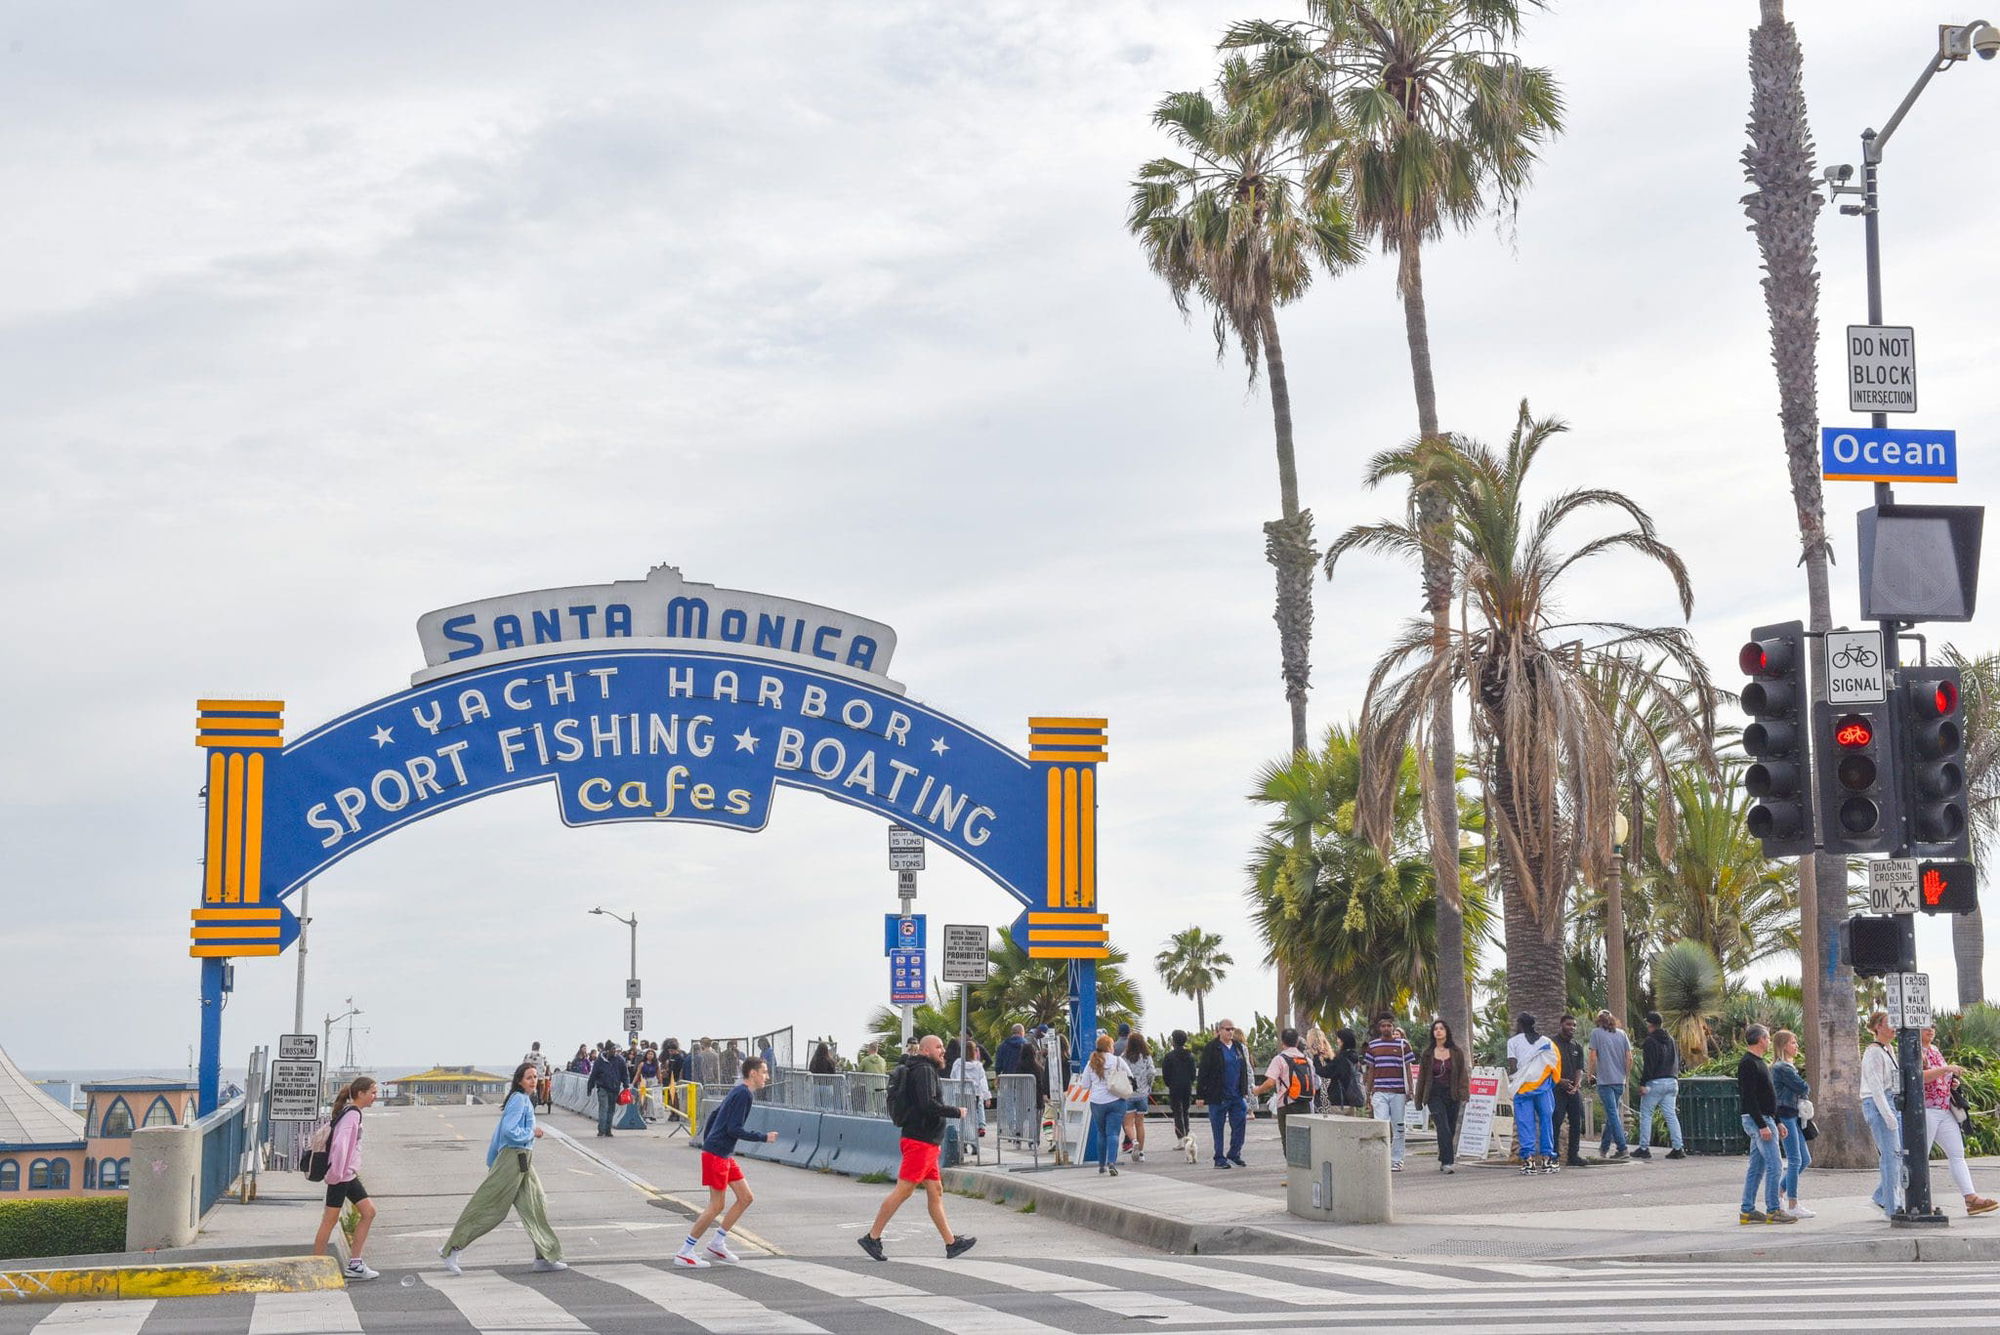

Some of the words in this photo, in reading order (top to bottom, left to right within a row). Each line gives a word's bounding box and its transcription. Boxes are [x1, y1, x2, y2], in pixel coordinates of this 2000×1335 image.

[1852, 337, 1874, 357] DO
[1879, 338, 1909, 358] NOT
[1853, 365, 1911, 385] BLOCK
[1853, 390, 1913, 405] INTERSECTION
[1832, 433, 1946, 465] Ocean
[442, 603, 632, 661] SANTA
[667, 596, 878, 671] MONICA
[1832, 677, 1881, 693] SIGNAL
[412, 666, 618, 735] YACHT
[669, 666, 912, 747] HARBOR
[306, 739, 469, 850] SPORT
[497, 712, 715, 774] FISHING
[774, 726, 998, 848] BOATING
[892, 838, 900, 846] 15
[901, 838, 922, 846] TONS
[902, 860, 921, 868] TONS
[1873, 861, 1912, 872] DIAGONAL
[901, 873, 914, 883] NO
[1874, 871, 1913, 882] CROSSING
[1872, 888, 1891, 909] OK
[946, 951, 986, 960] PROHIBITED
[1904, 976, 1928, 986] CROSS
[1907, 995, 1926, 1005] WALK
[1904, 1005, 1930, 1015] SIGNAL
[630, 1020, 637, 1029] 5
[1909, 1015, 1927, 1025] ONLY
[293, 1038, 304, 1046] USE
[282, 1047, 315, 1056] CROSSWALK
[273, 1088, 317, 1097] PROHIBITED
